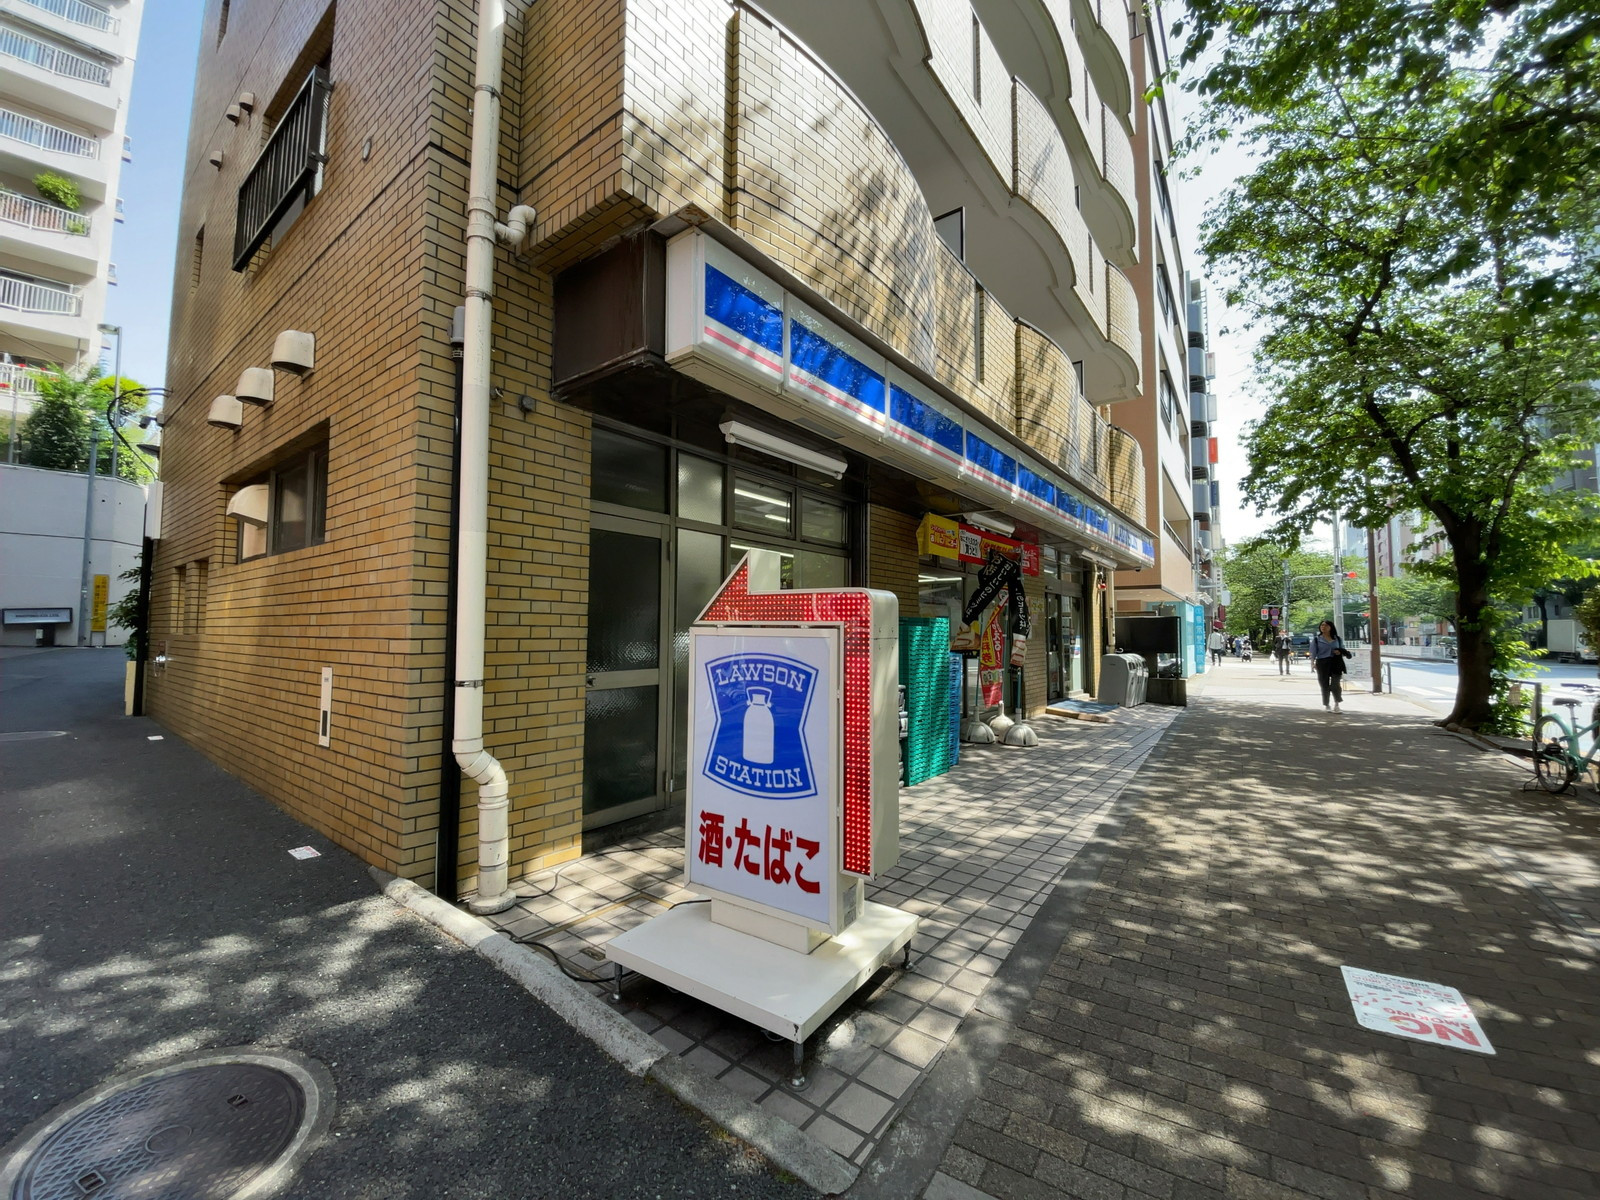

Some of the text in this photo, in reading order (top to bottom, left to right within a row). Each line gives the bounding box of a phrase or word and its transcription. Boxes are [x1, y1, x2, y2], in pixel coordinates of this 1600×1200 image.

[715, 663, 807, 692] LAWSON
[714, 756, 803, 788] STATION
[698, 809, 821, 894] 酒・たばこ
[1382, 1007, 1471, 1029] SMOKING
